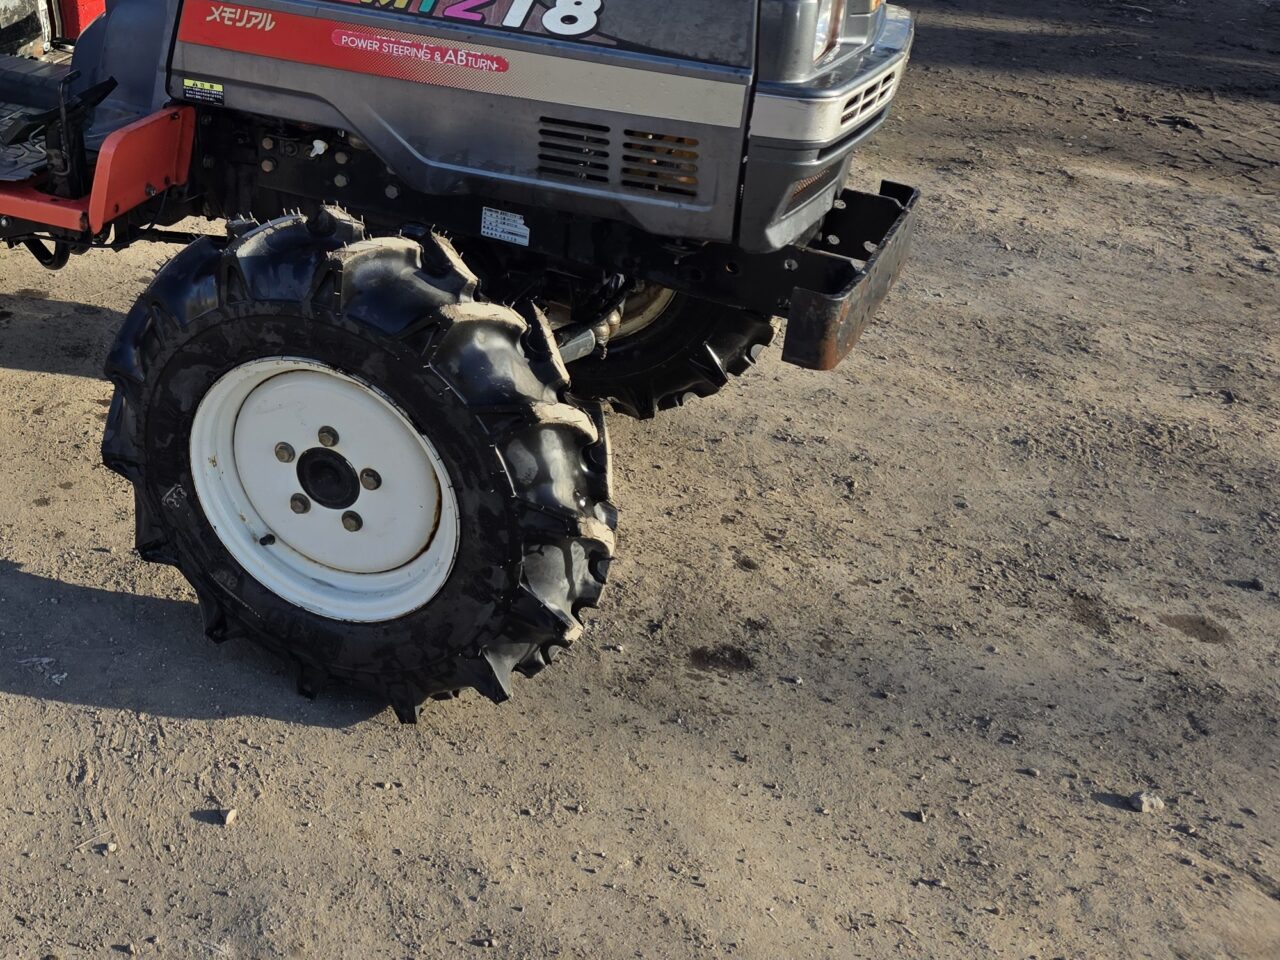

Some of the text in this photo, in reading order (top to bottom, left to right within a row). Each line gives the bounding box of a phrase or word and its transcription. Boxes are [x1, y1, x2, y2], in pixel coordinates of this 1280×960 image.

[205, 5, 276, 32] メモリアル
[341, 35, 380, 51] POWER
[382, 42, 431, 60] STEERING
[434, 51, 441, 61] &
